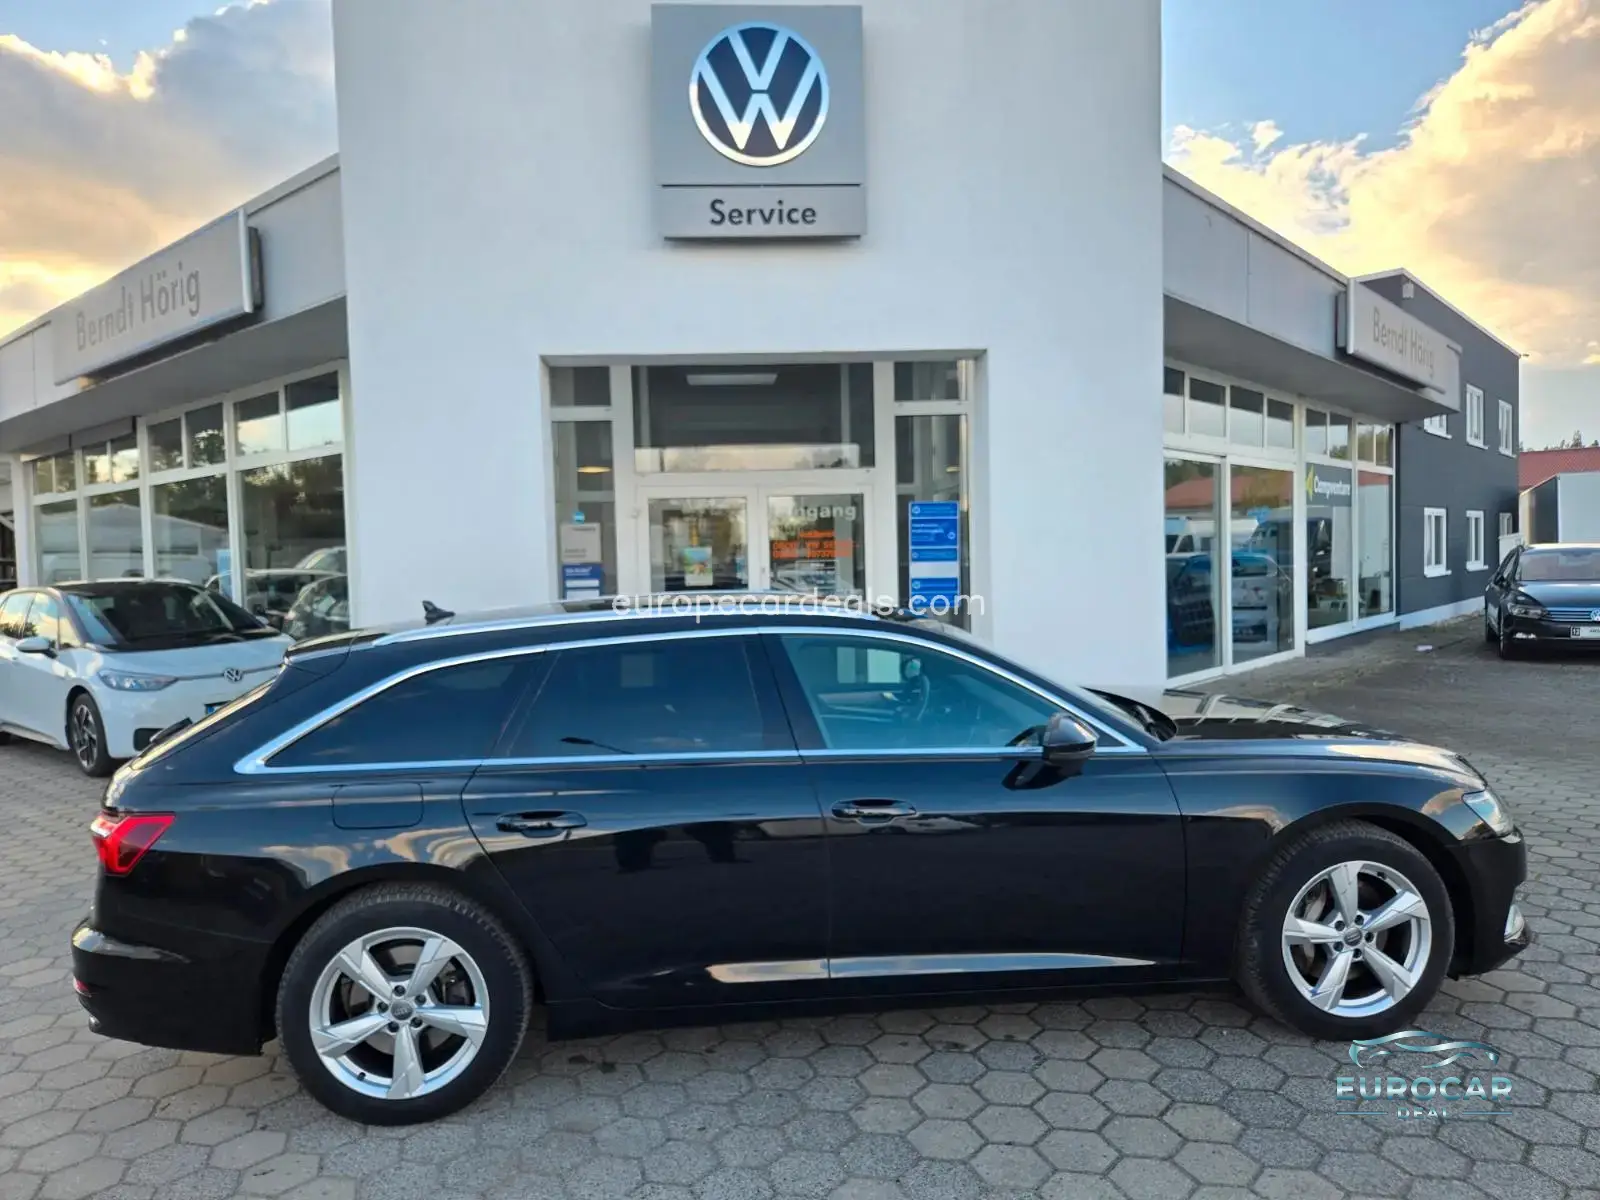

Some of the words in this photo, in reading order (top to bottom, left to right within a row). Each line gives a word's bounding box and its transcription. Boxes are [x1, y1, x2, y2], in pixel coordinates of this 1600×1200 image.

[709, 199, 817, 225] Service
[76, 285, 134, 352] Berndt
[140, 260, 200, 324] Hörig
[1373, 305, 1407, 357] Berndt
